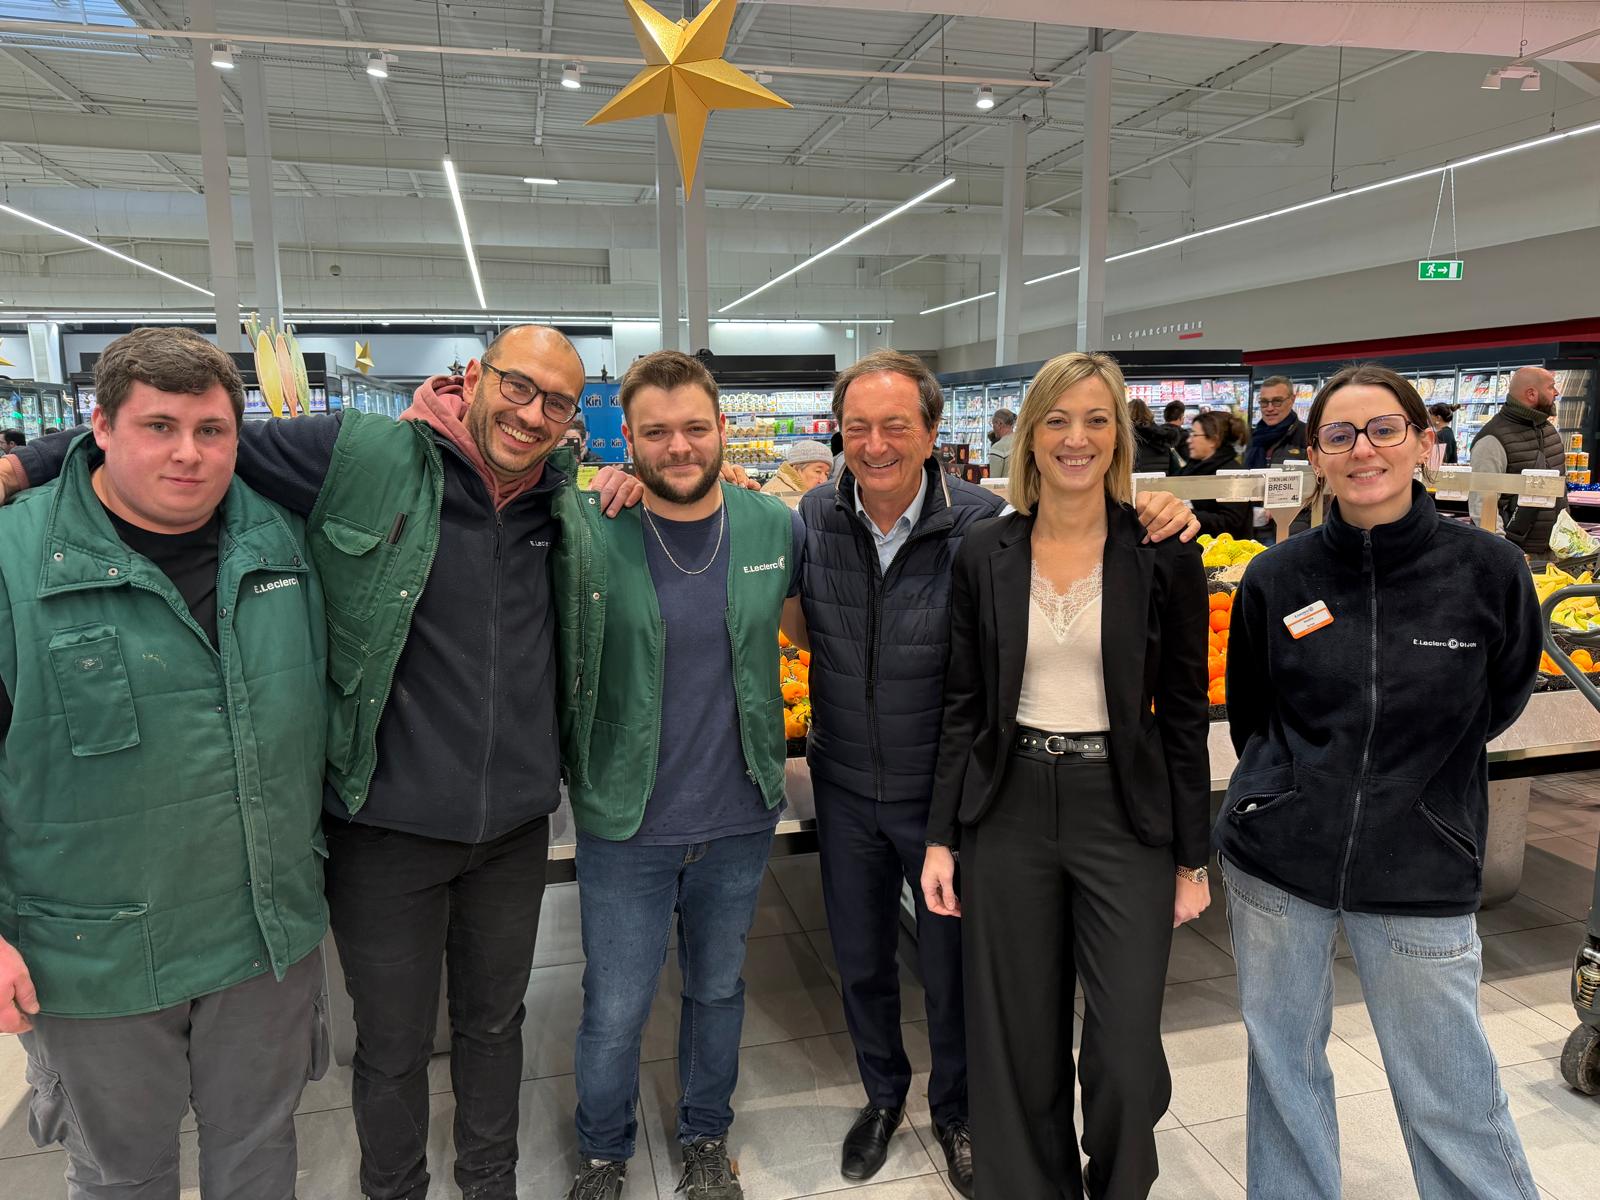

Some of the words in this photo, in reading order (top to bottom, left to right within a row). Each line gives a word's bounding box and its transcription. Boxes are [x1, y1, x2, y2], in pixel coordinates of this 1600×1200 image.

[1111, 333, 1121, 342] LA
[1128, 320, 1203, 339] CHARCUTERIE
[585, 395, 602, 407] Kiri
[609, 395, 621, 407] Ki
[592, 439, 605, 448] Kiri
[1268, 483, 1294, 491] BRESIL
[743, 562, 778, 574] E.Leclerc
[253, 577, 297, 594] E.Leclerc
